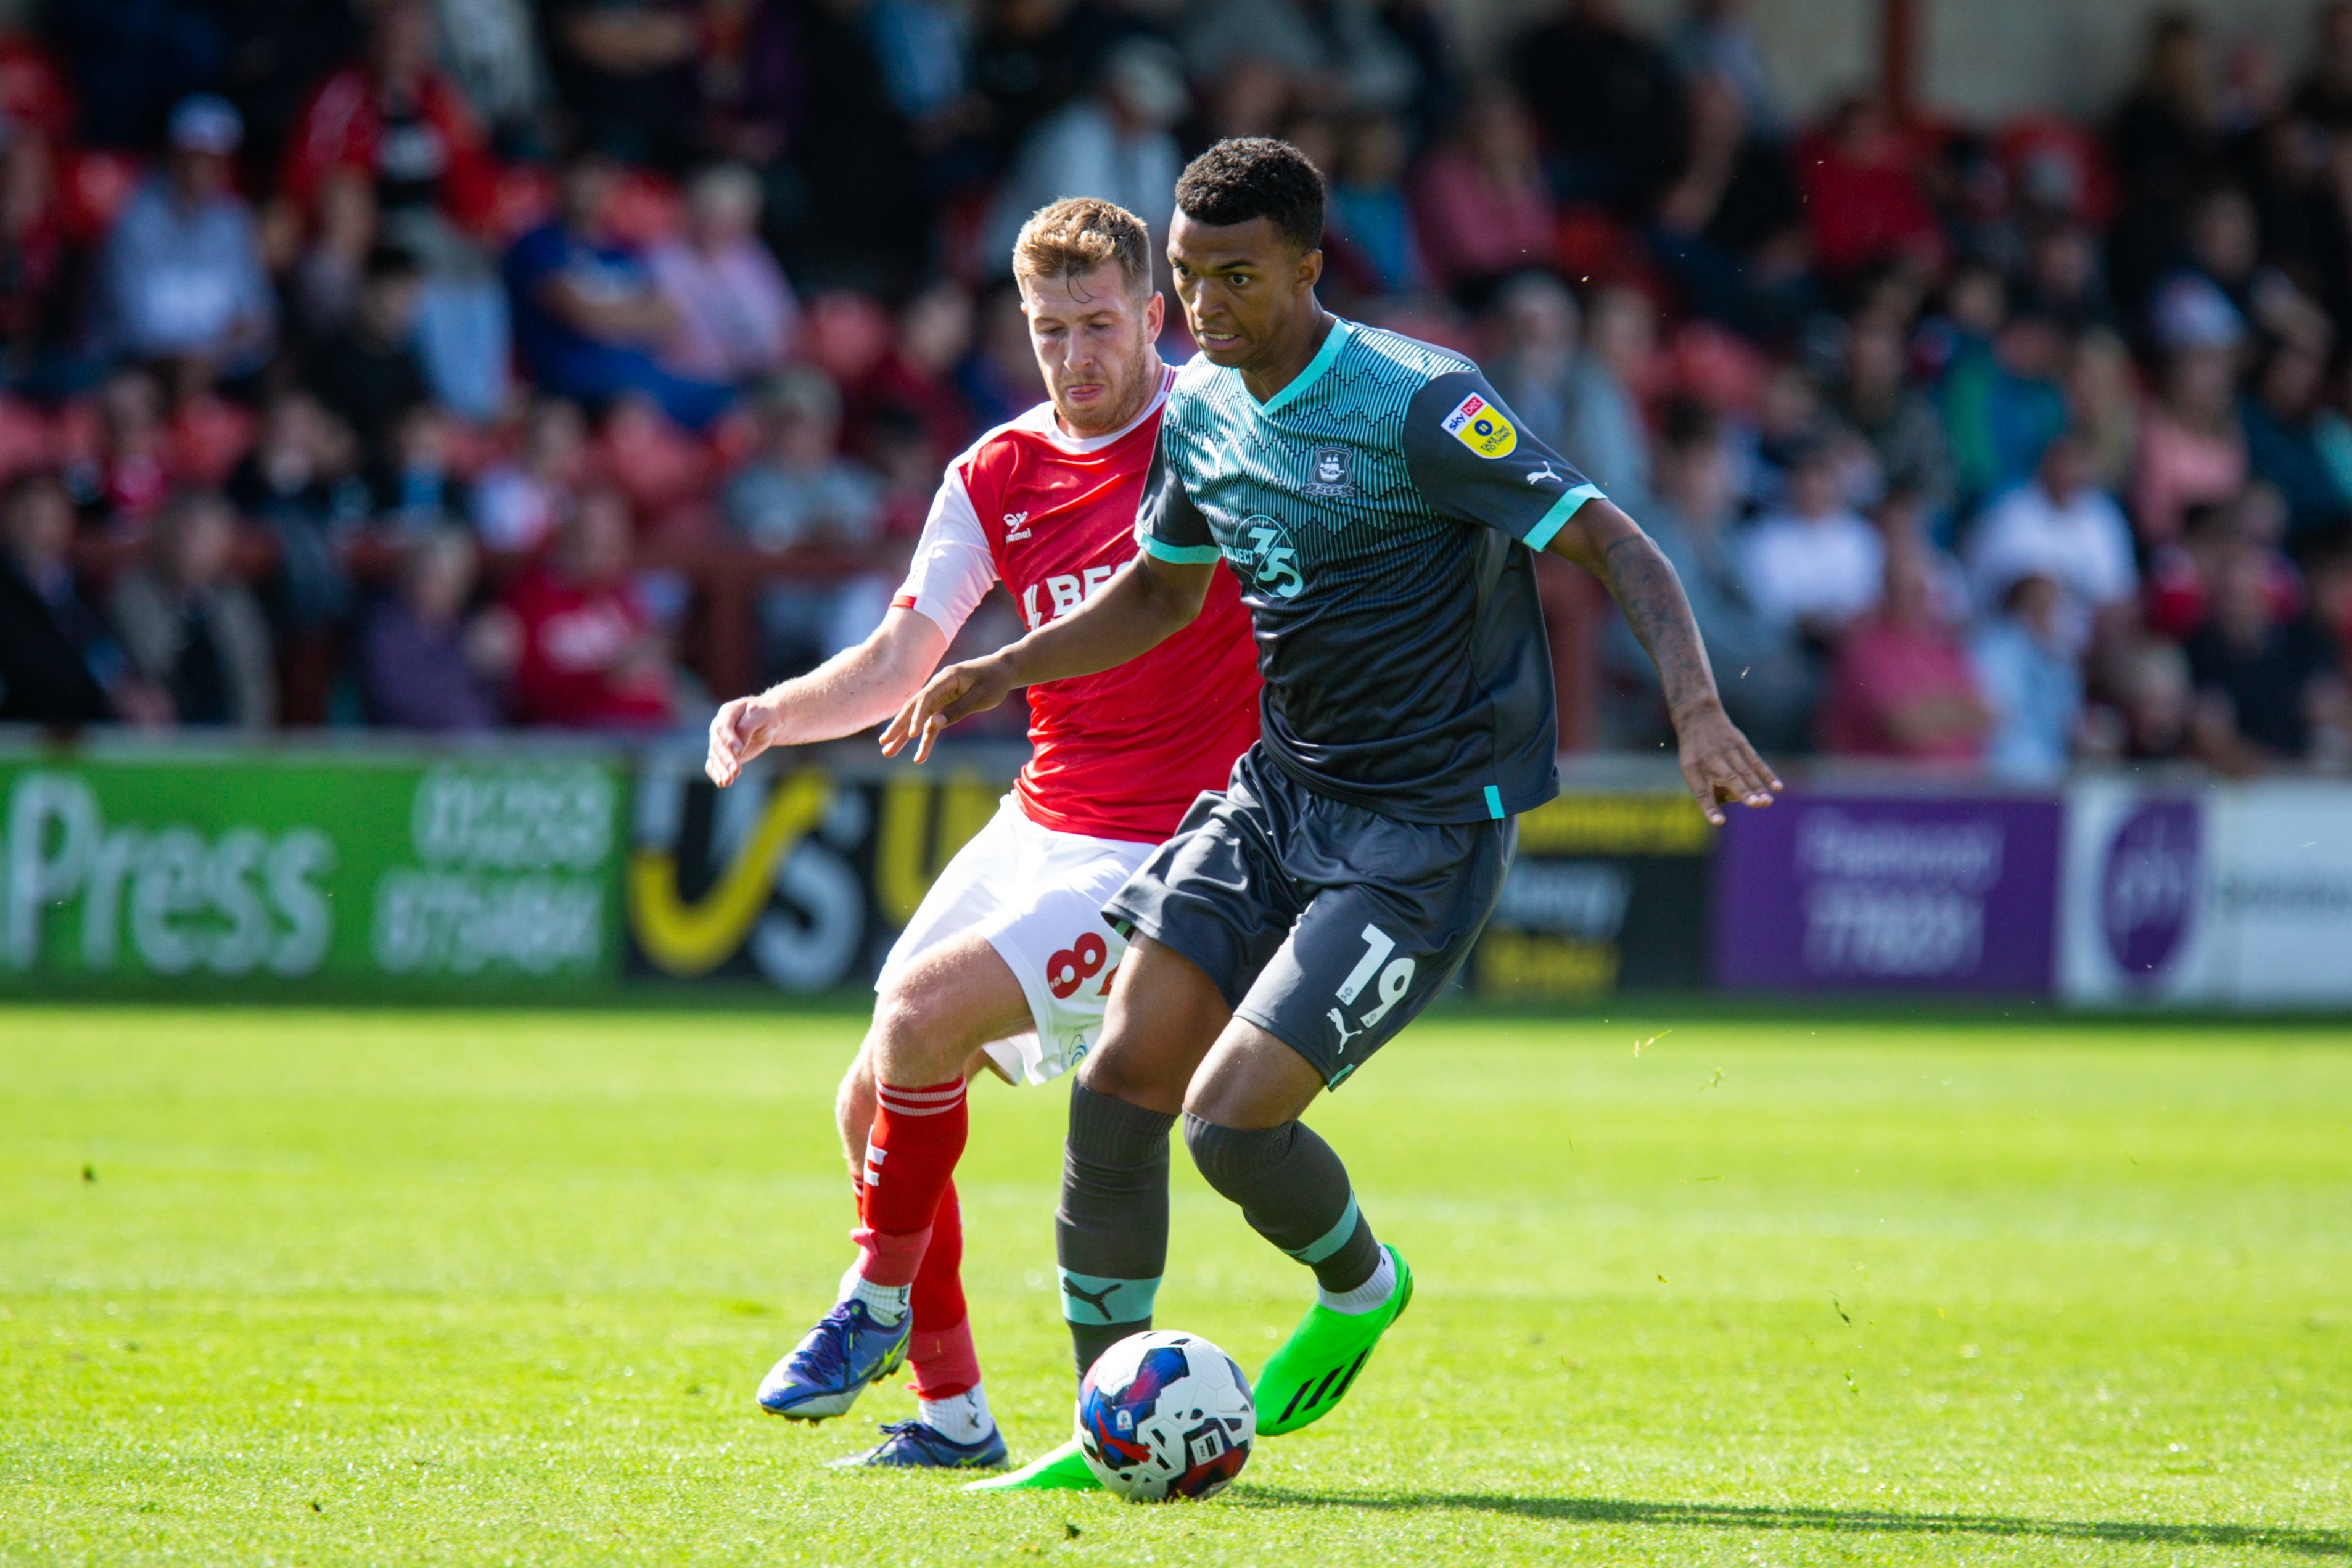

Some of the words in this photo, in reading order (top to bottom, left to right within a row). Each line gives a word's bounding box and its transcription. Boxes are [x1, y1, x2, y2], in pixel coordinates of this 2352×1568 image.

[1449, 413, 1465, 430] sky
[1463, 399, 1480, 414] bet
[1480, 435, 1497, 451] TAKE
[1220, 543, 1254, 565] PROJECT
[1046, 560, 1132, 617] BE
[5, 774, 335, 969] Press
[1335, 922, 1417, 1029] 19
